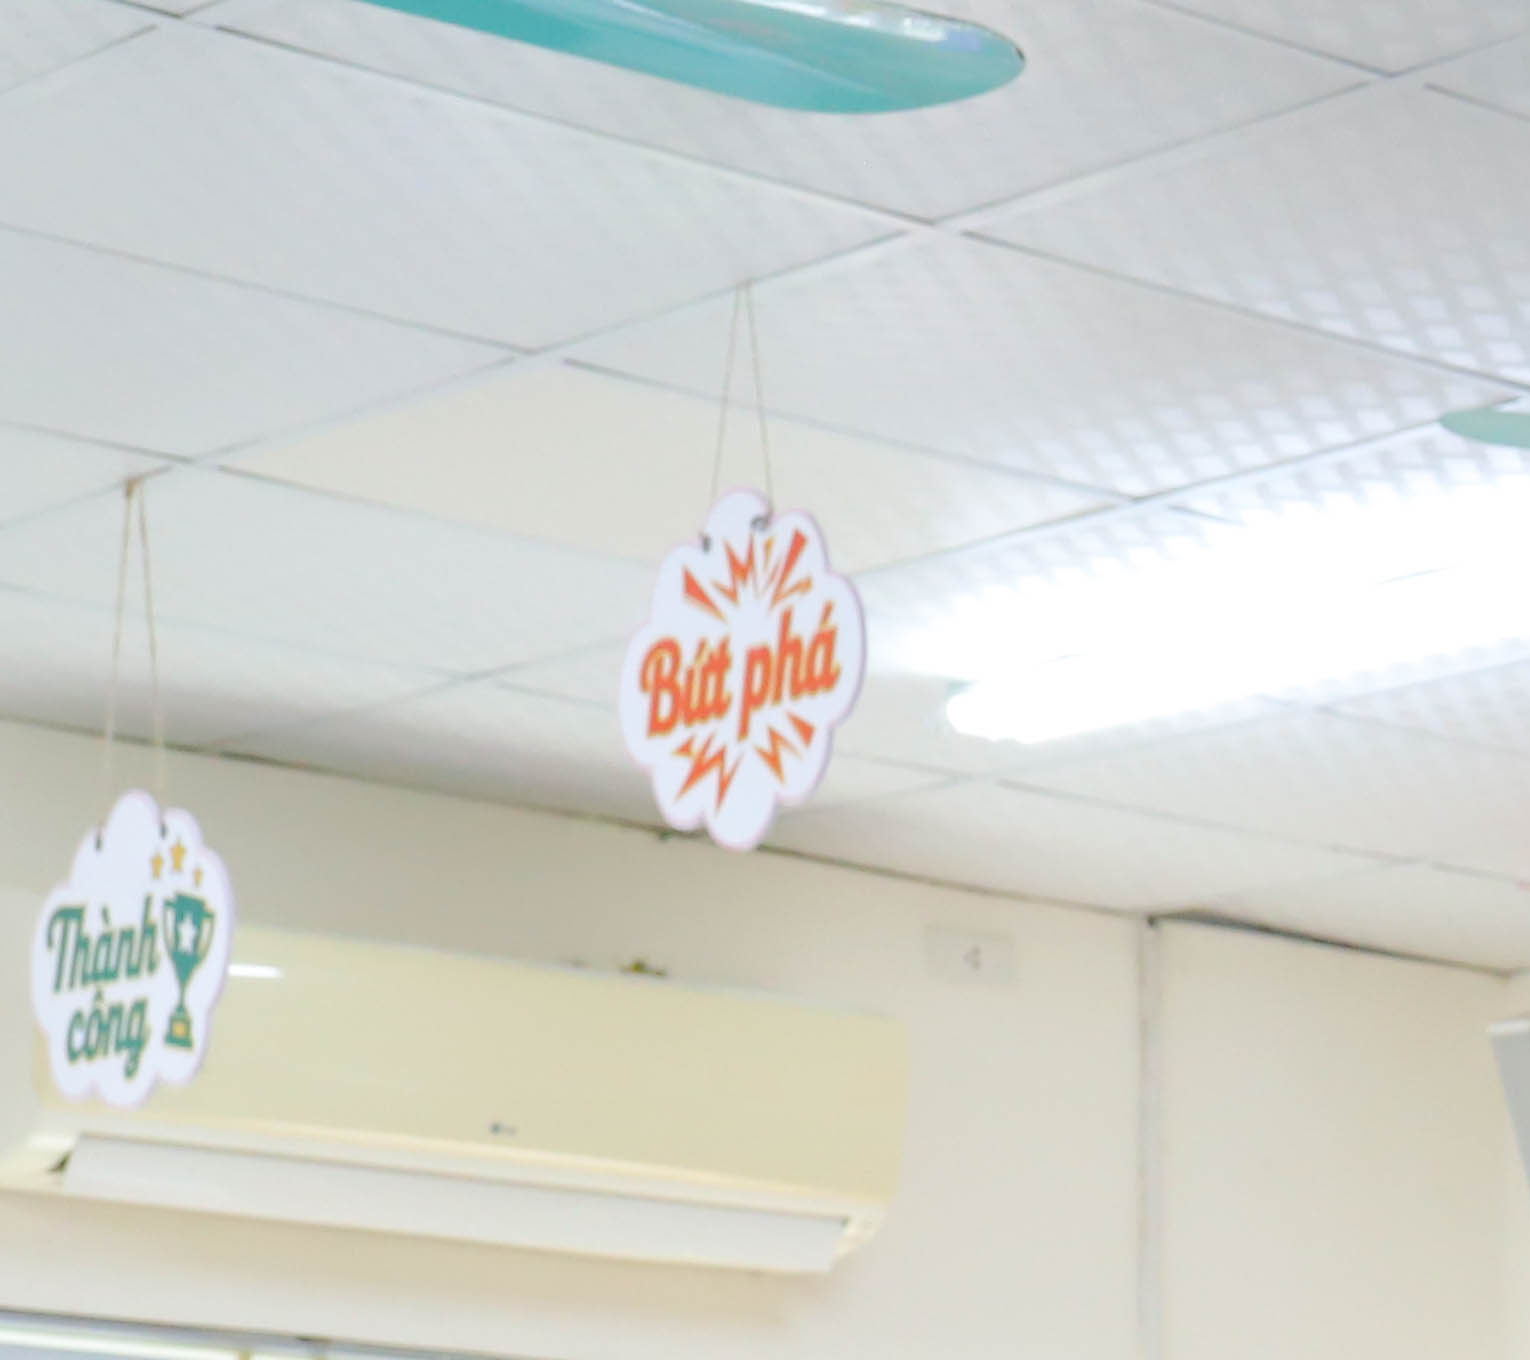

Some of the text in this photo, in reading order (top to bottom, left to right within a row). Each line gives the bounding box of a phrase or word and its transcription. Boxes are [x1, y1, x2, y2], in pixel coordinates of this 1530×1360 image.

[640, 600, 842, 742] Bứt phá
[46, 893, 159, 994] Thành
[65, 988, 151, 1080] công
